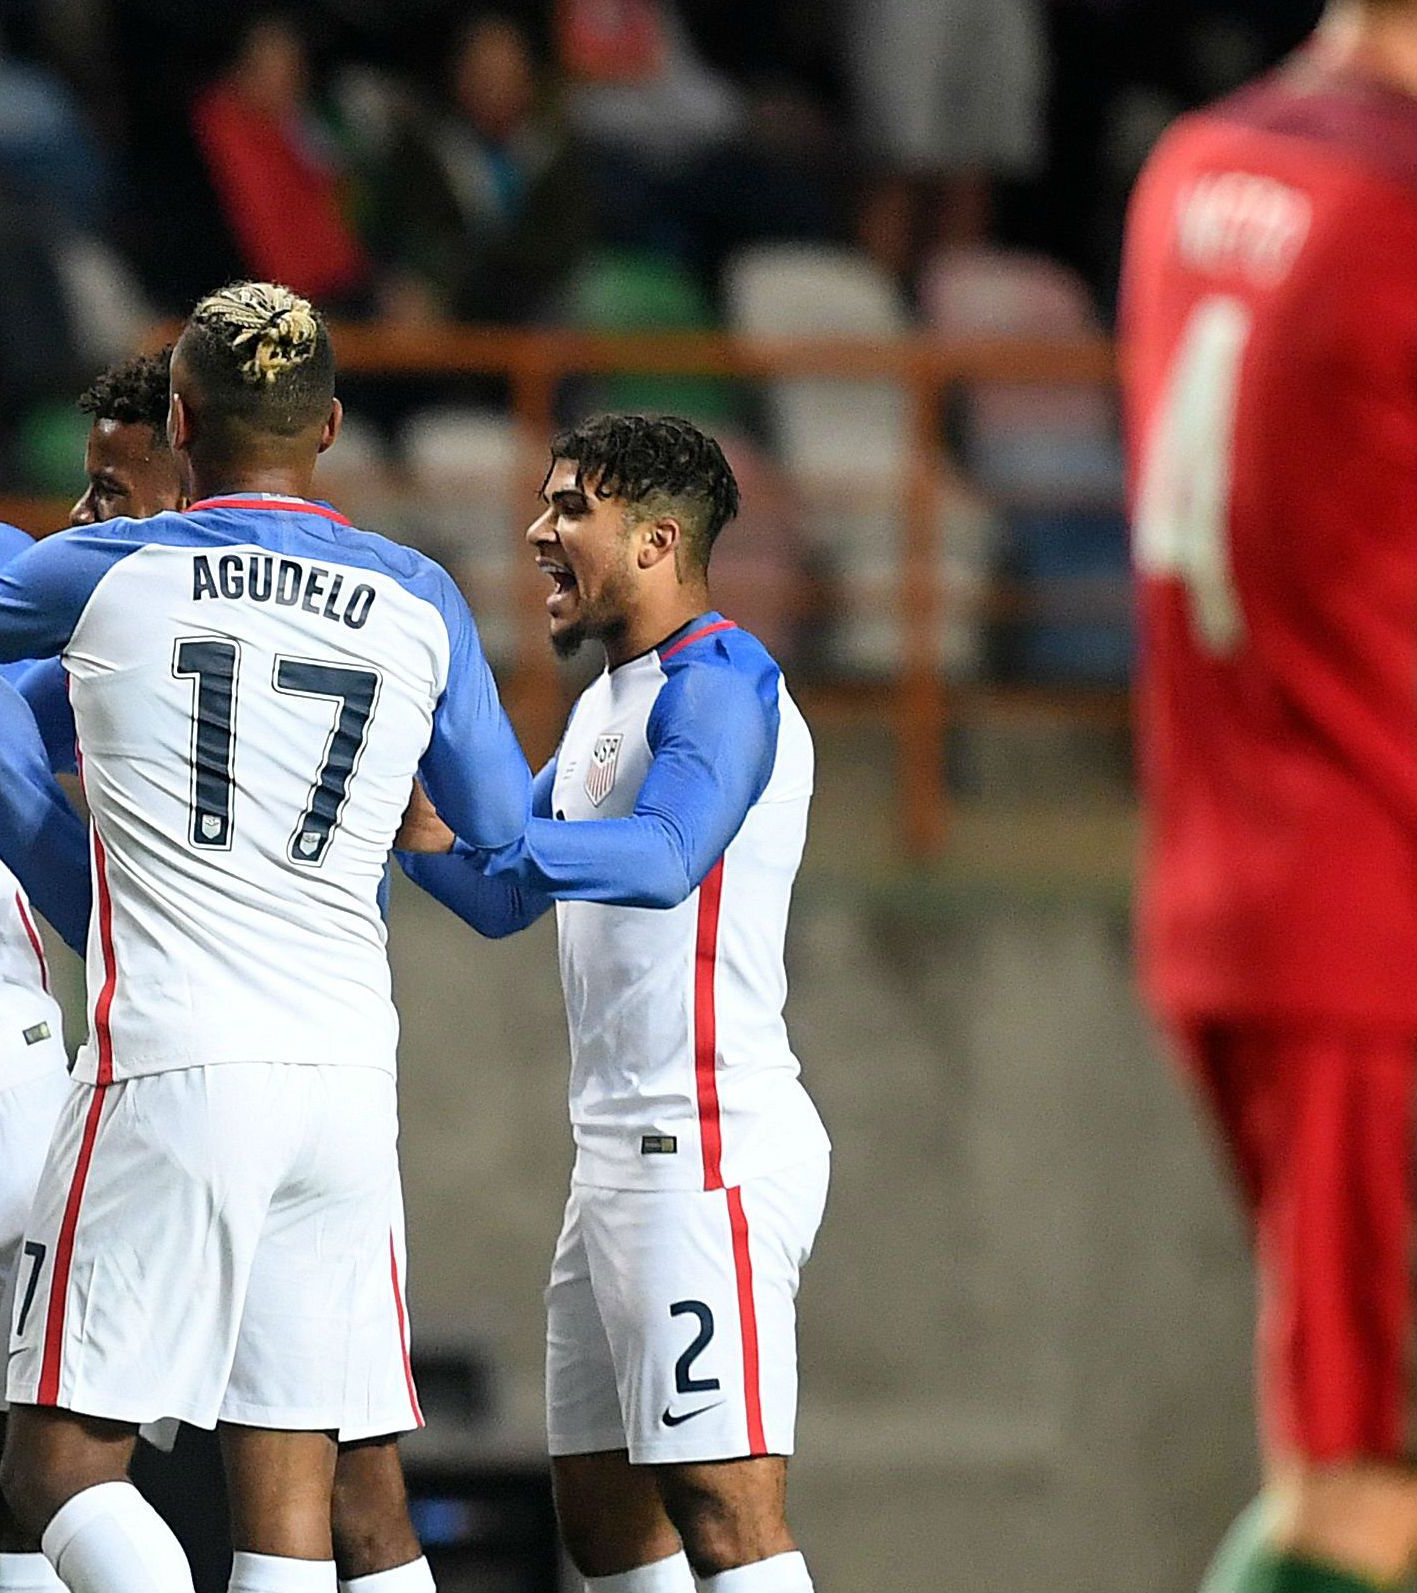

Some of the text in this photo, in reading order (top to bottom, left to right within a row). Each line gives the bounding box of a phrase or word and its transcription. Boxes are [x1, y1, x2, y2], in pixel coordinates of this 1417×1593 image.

[1133, 297, 1253, 660] 4
[192, 554, 377, 630] AGUDELO
[172, 635, 383, 867] 17
[593, 738, 619, 763] USA
[16, 1240, 47, 1337] 7
[669, 1299, 721, 1394] 2
